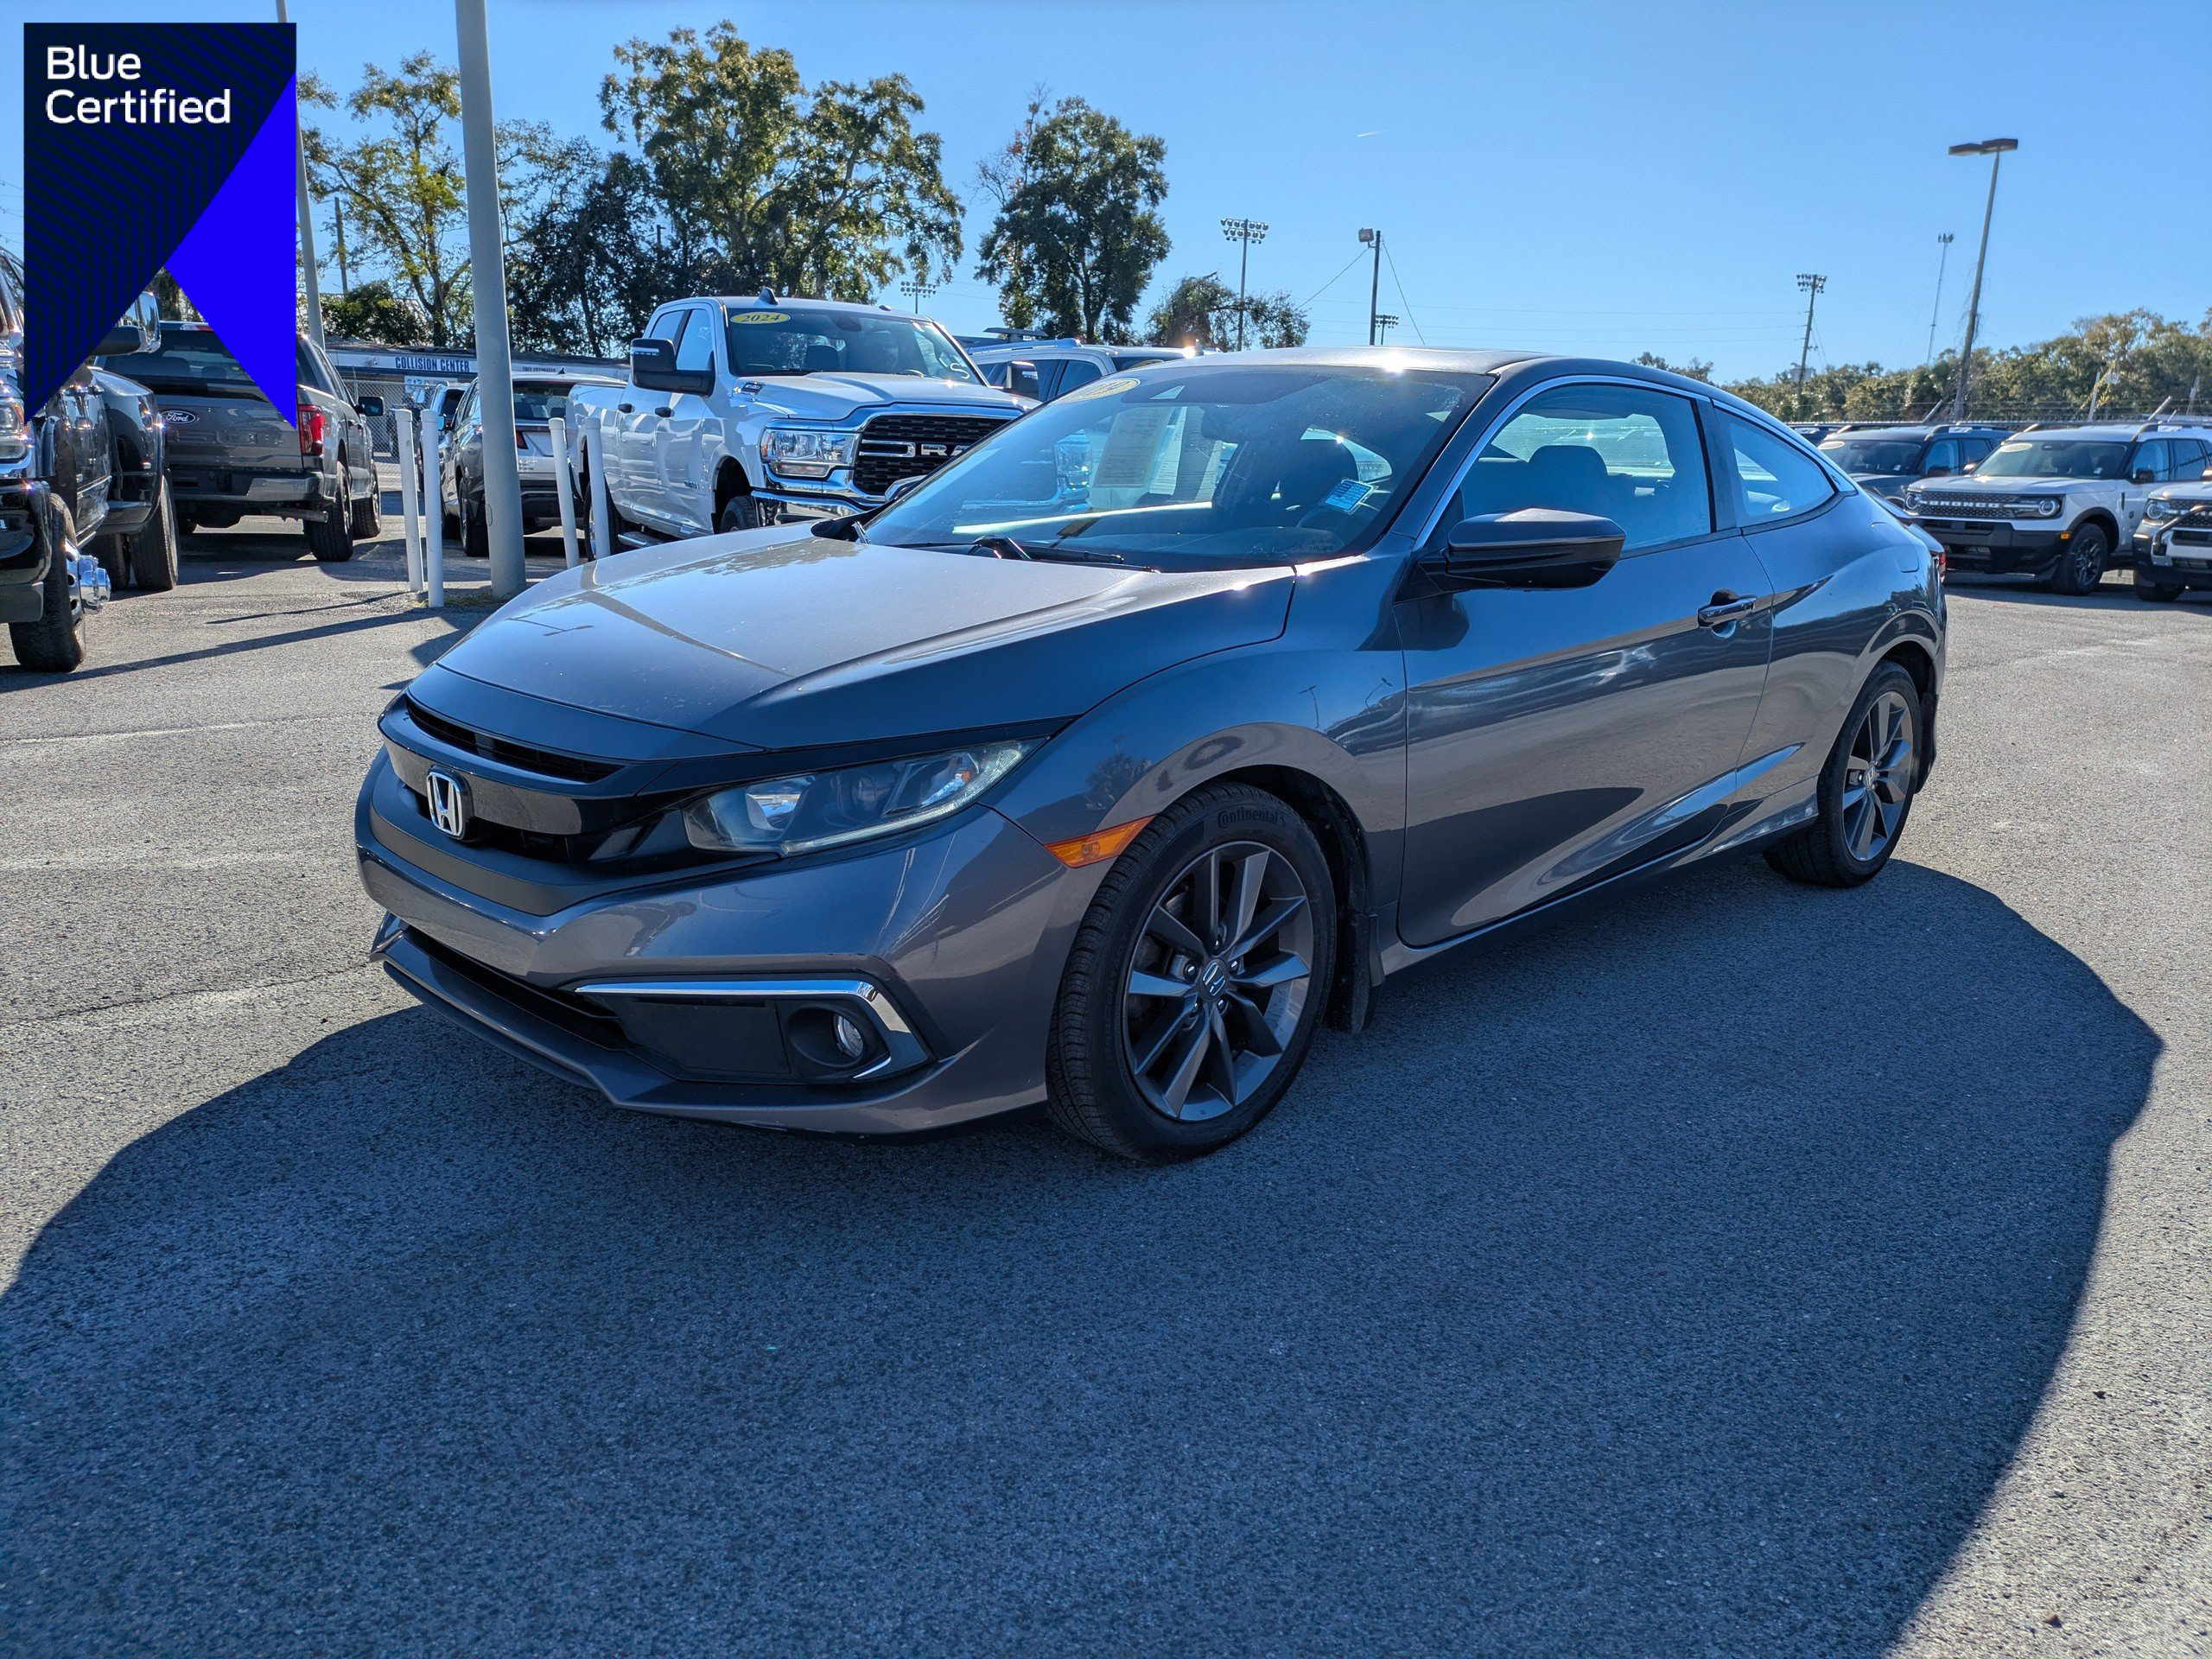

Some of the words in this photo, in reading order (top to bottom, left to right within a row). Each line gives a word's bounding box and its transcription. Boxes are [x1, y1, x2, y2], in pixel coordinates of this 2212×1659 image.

[741, 314, 781, 322] 2024
[395, 357, 437, 371] COLLISION
[440, 359, 470, 372] CENTER
[166, 412, 189, 422] Ford
[921, 443, 970, 456] RA
[1217, 807, 1278, 829] Continental
